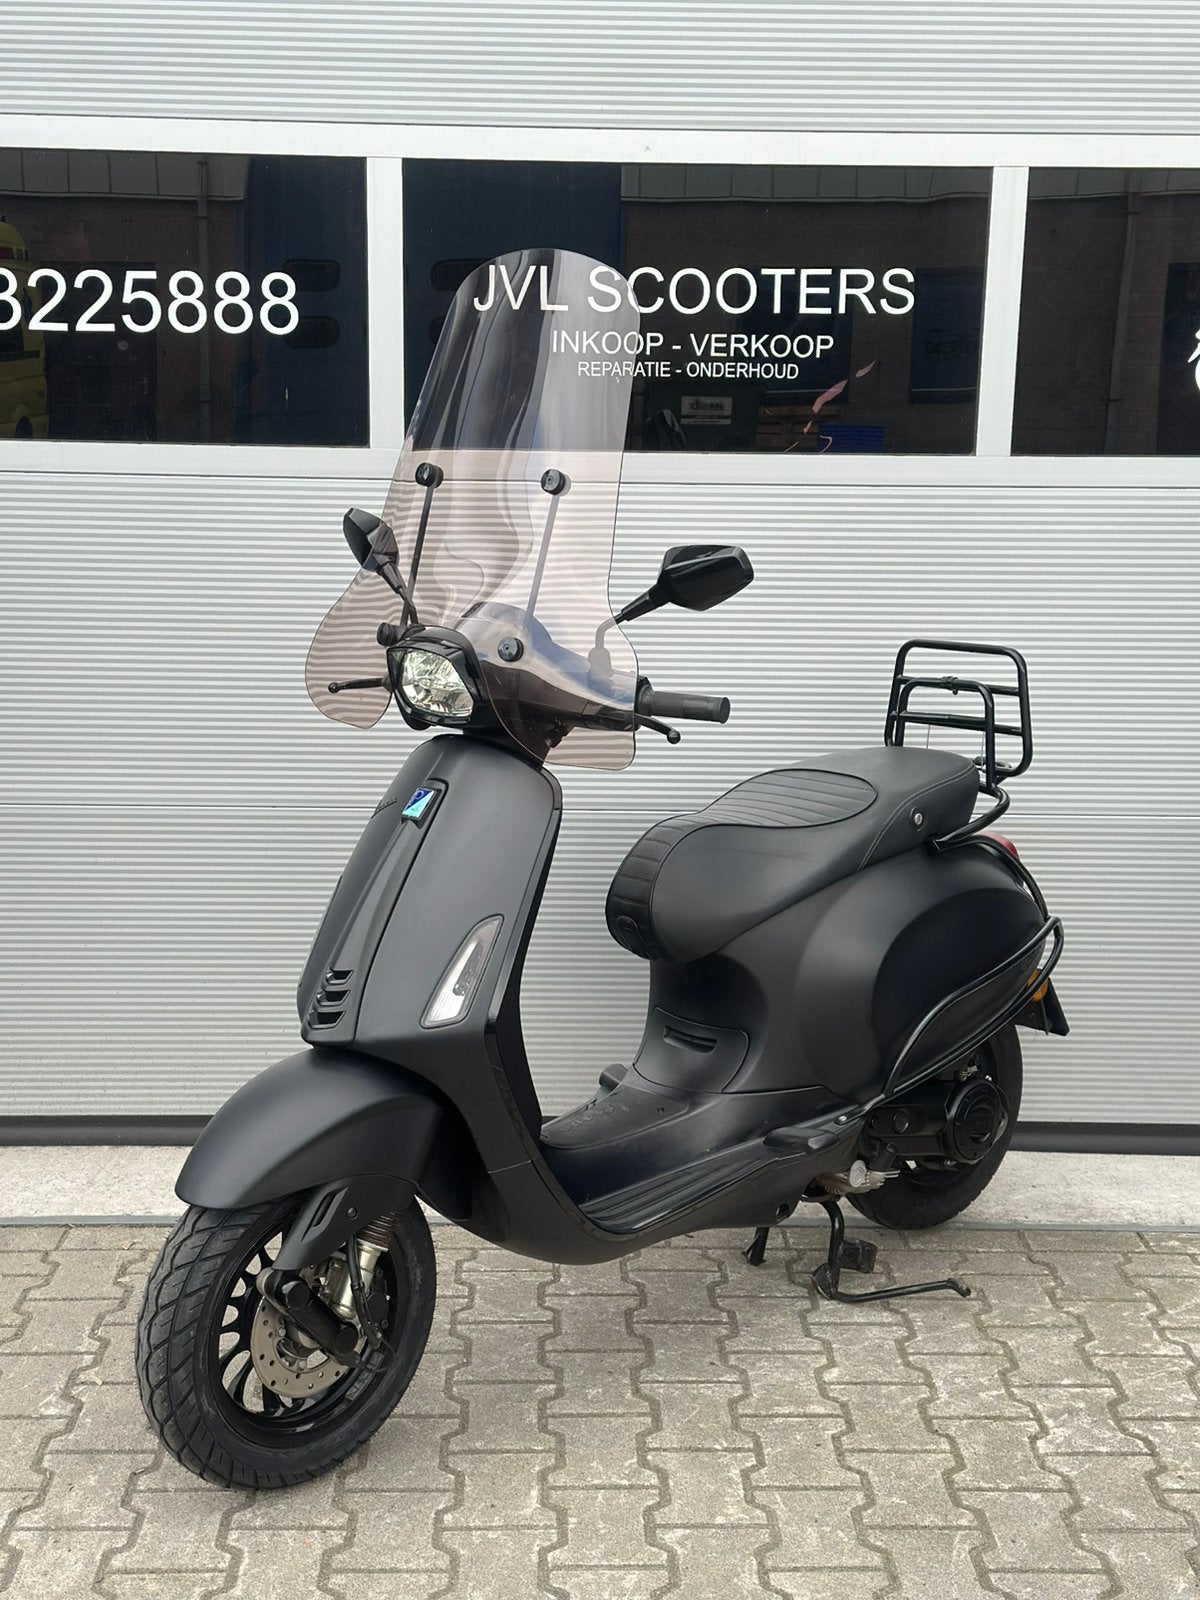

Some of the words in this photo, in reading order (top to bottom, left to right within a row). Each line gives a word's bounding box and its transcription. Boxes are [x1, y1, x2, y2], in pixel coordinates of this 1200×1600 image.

[473, 264, 569, 312] JVL
[587, 265, 915, 315] SCOOTERS
[552, 330, 664, 356] INKOOP
[689, 333, 834, 358] VERKOOP
[578, 361, 671, 377] REPARATIE
[686, 361, 799, 379] ONDERHOUD
